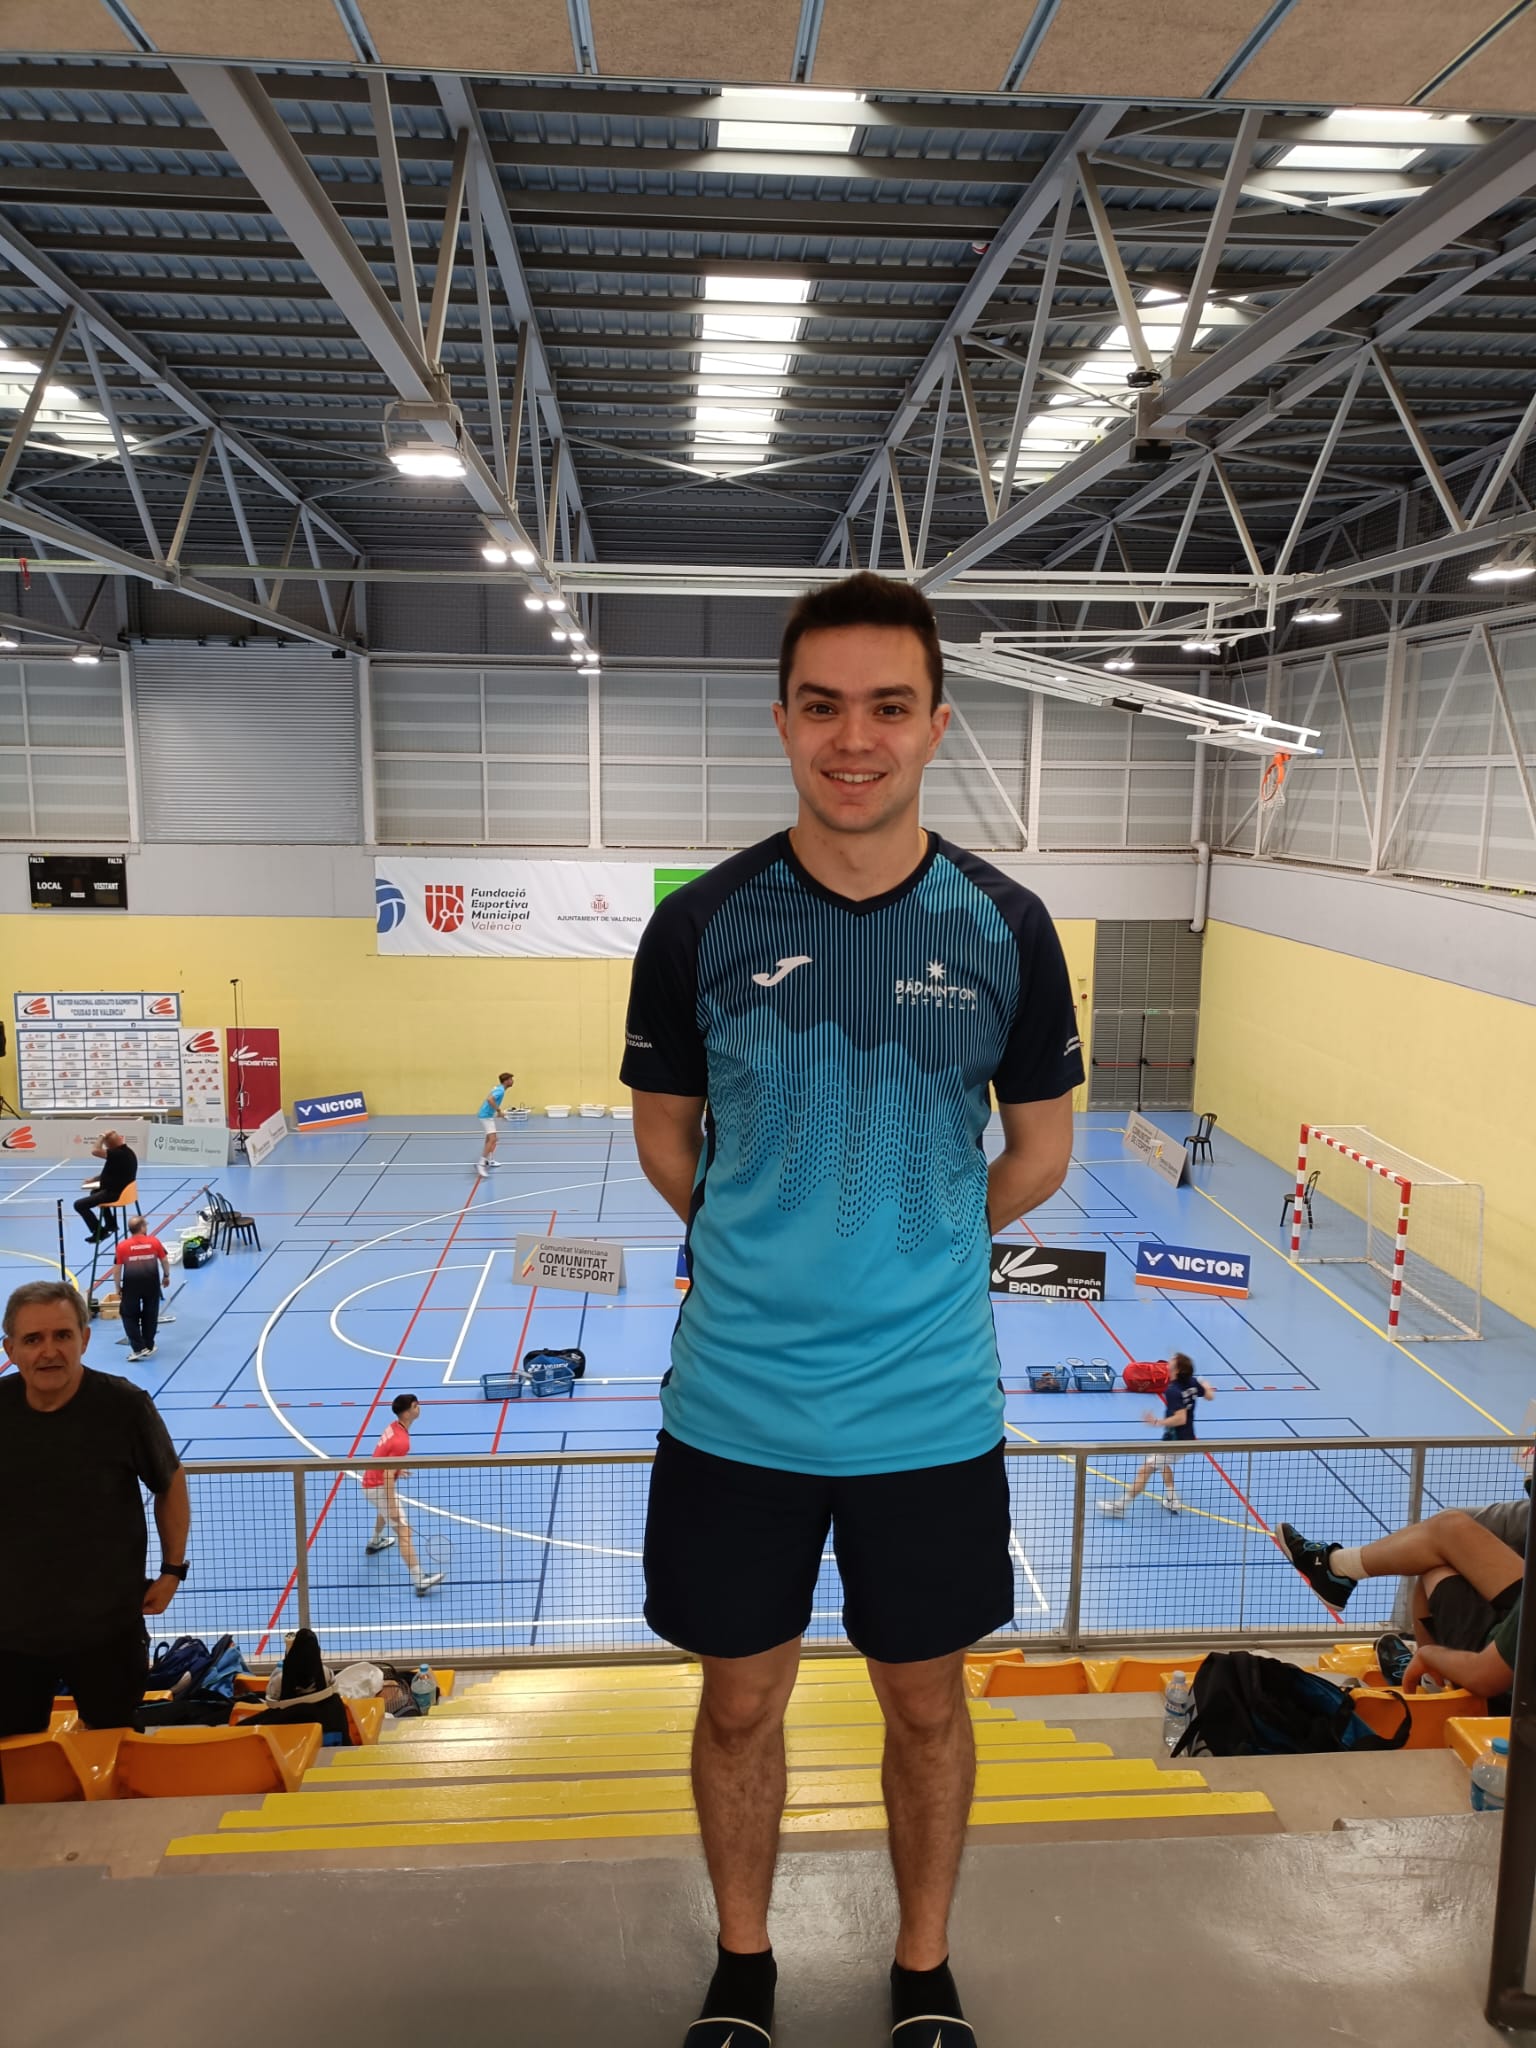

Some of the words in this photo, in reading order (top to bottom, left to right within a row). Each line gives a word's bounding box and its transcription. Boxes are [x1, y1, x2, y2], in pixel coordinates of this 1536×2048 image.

[36, 881, 63, 890] LOCAL
[471, 888, 526, 898] Fundació
[471, 899, 528, 911] Esportiva
[471, 910, 530, 922] Municipal
[471, 921, 522, 931] València
[896, 996, 976, 1011] ESTELLA
[314, 1097, 363, 1114] VICTOR
[540, 1243, 573, 1253] Comunitat
[574, 1247, 608, 1257] Valenciana
[538, 1252, 608, 1270] COMUNITAT
[1167, 1253, 1245, 1278] VICTOR
[542, 1264, 558, 1276] DE
[560, 1266, 616, 1283] L'ESPORT
[1067, 1277, 1101, 1286] ESPAÑA
[1008, 1281, 1101, 1300] BADMINTON
